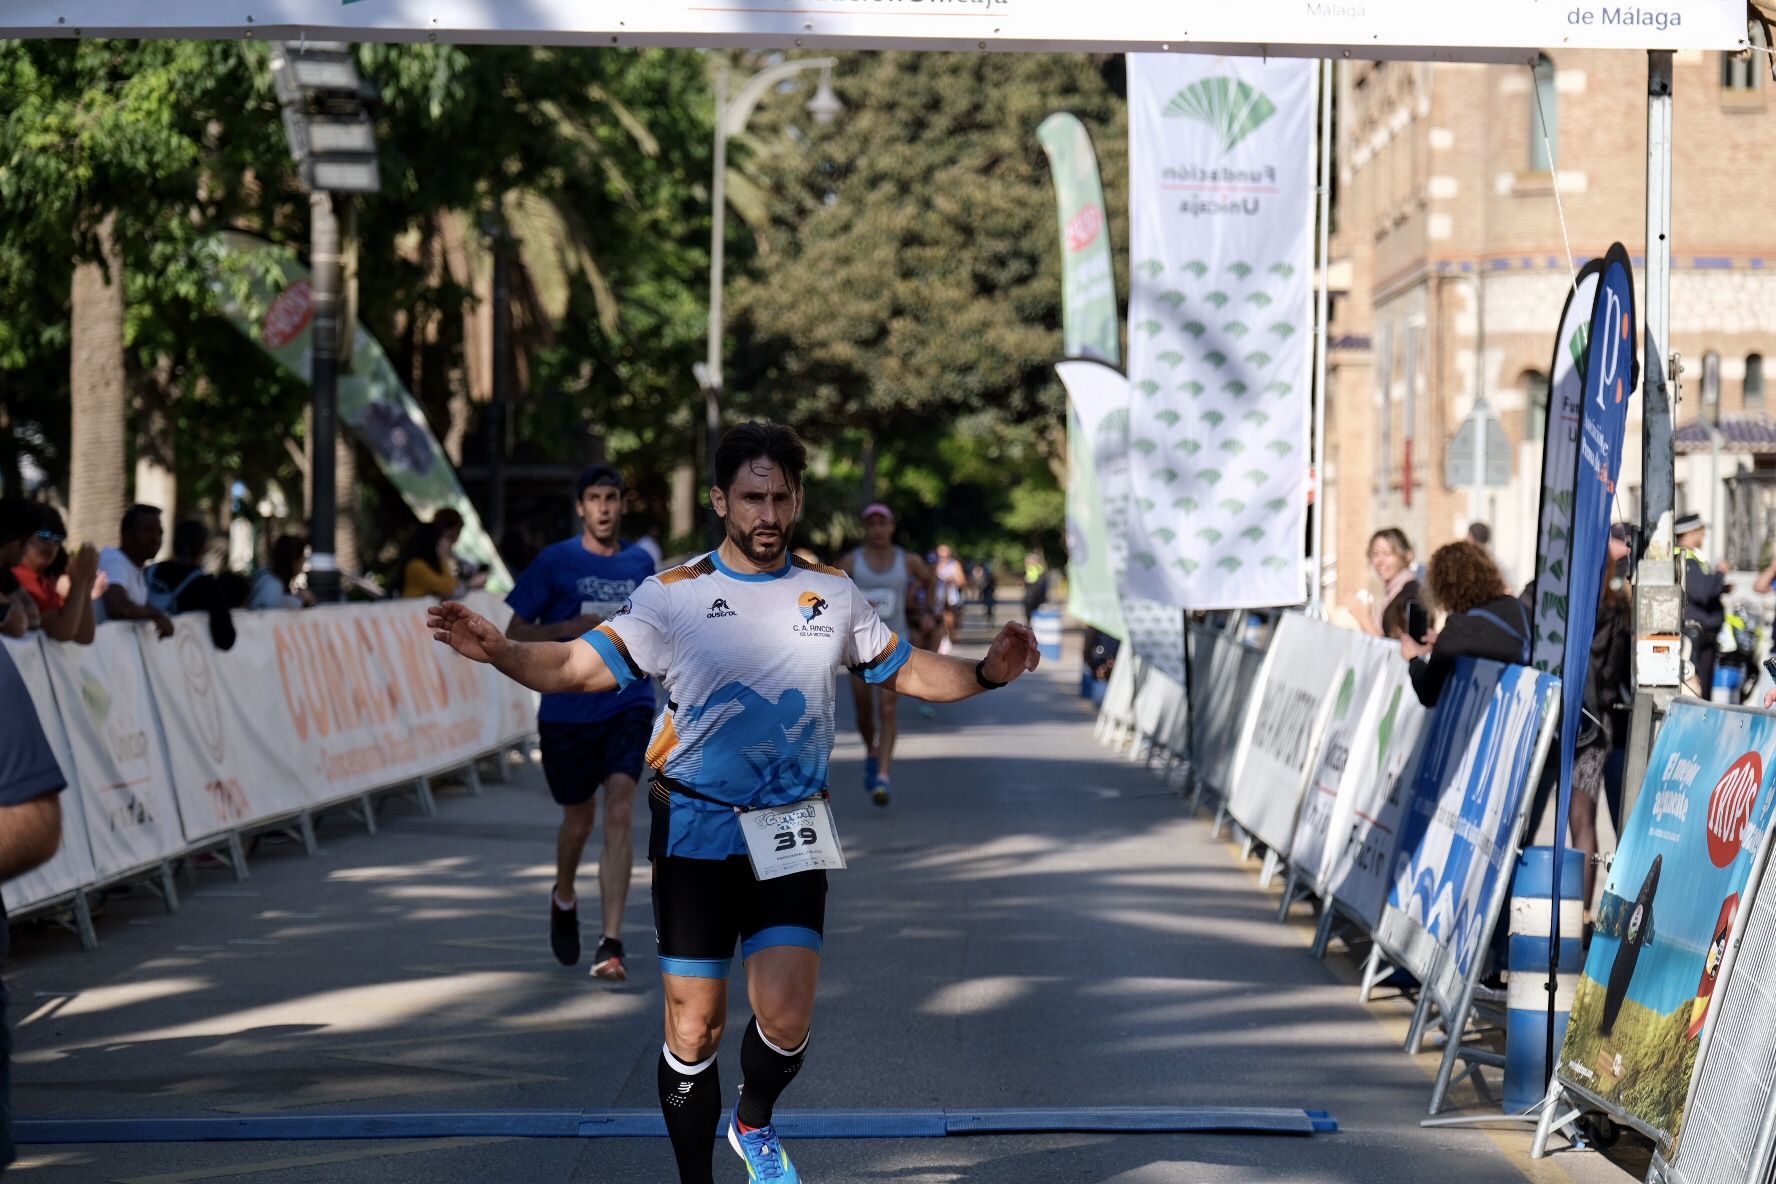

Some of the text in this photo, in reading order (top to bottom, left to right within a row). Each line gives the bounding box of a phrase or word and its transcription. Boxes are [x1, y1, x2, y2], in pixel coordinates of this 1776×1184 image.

[1567, 6, 1682, 31] de Málaga
[810, 624, 834, 634] RINCÓN
[1671, 753, 1700, 790] mejor
[1709, 761, 1758, 843] TROPS
[773, 827, 818, 852] 39
